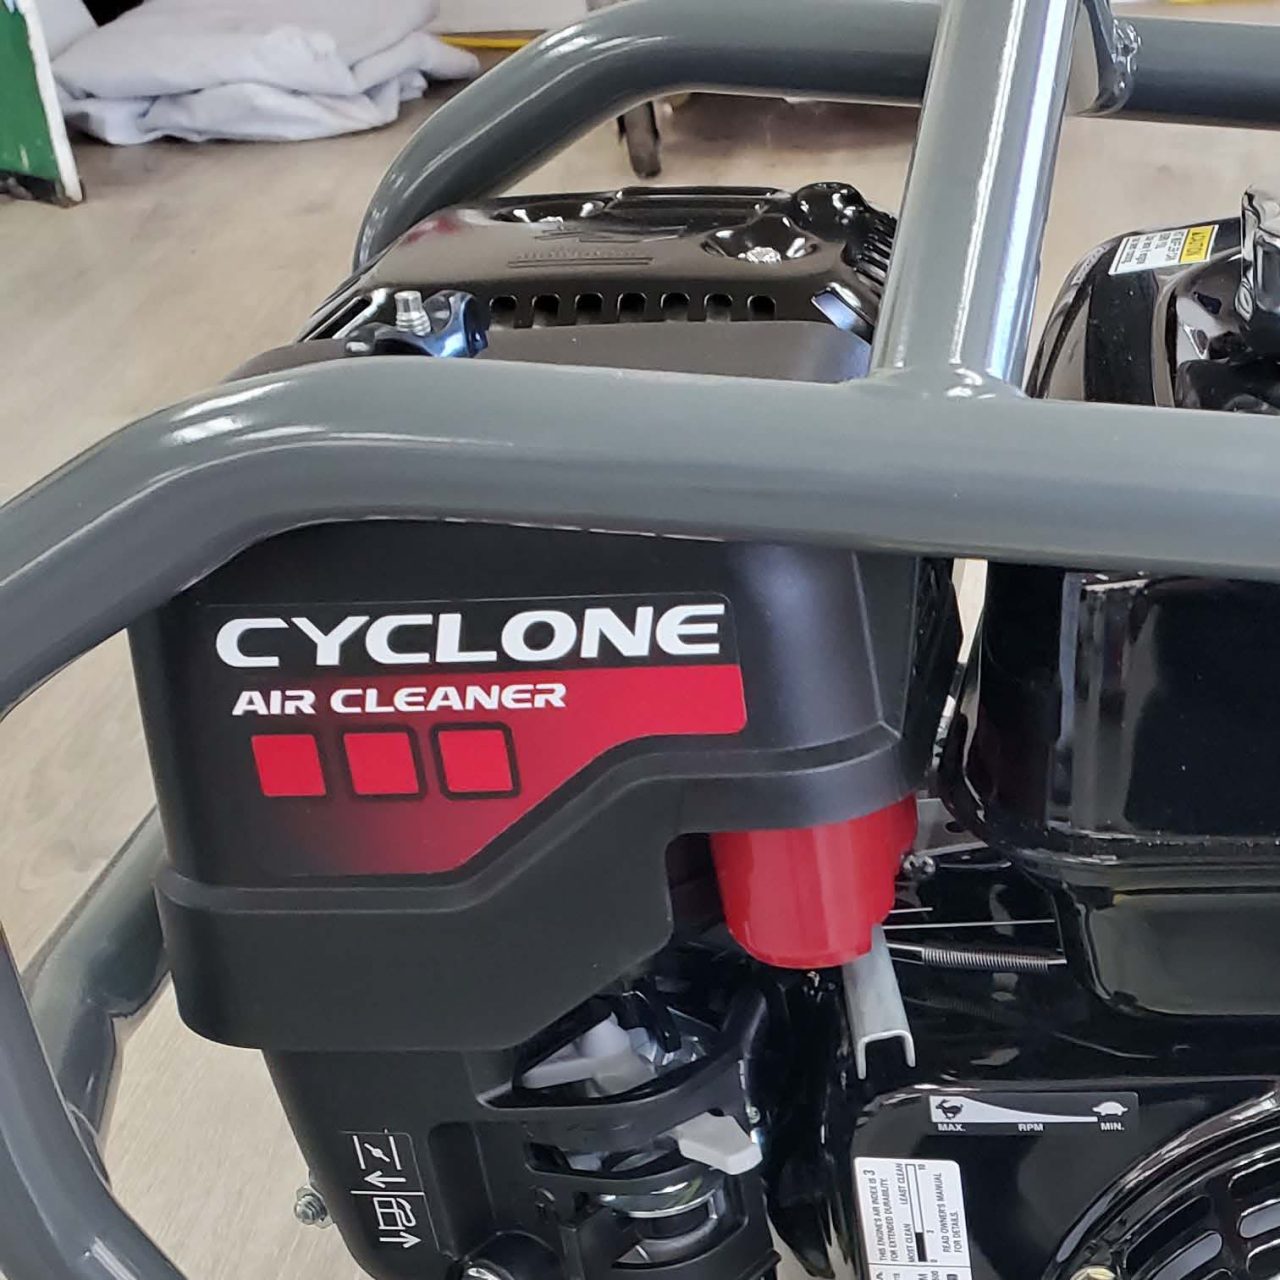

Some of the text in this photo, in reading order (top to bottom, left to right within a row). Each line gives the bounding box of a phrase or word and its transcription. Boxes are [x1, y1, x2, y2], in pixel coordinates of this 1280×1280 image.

[216, 603, 725, 668] CYCLONE
[232, 683, 567, 716] AIR CLEANER
[938, 1124, 966, 1132] MAX.
[1018, 1123, 1044, 1132] RPM
[1100, 1122, 1124, 1131] MIN.
[896, 1163, 908, 1205] LEAST CLEAN
[933, 1173, 944, 1201] MANUAL
[870, 1186, 880, 1204] INDEX
[872, 1206, 881, 1217] AIR
[886, 1216, 897, 1248] EXTENDED
[903, 1224, 915, 1262] MOST CLEAN
[941, 1235, 951, 1253] READ
[953, 1240, 962, 1253] FOR
[890, 1250, 899, 1261] FOR
